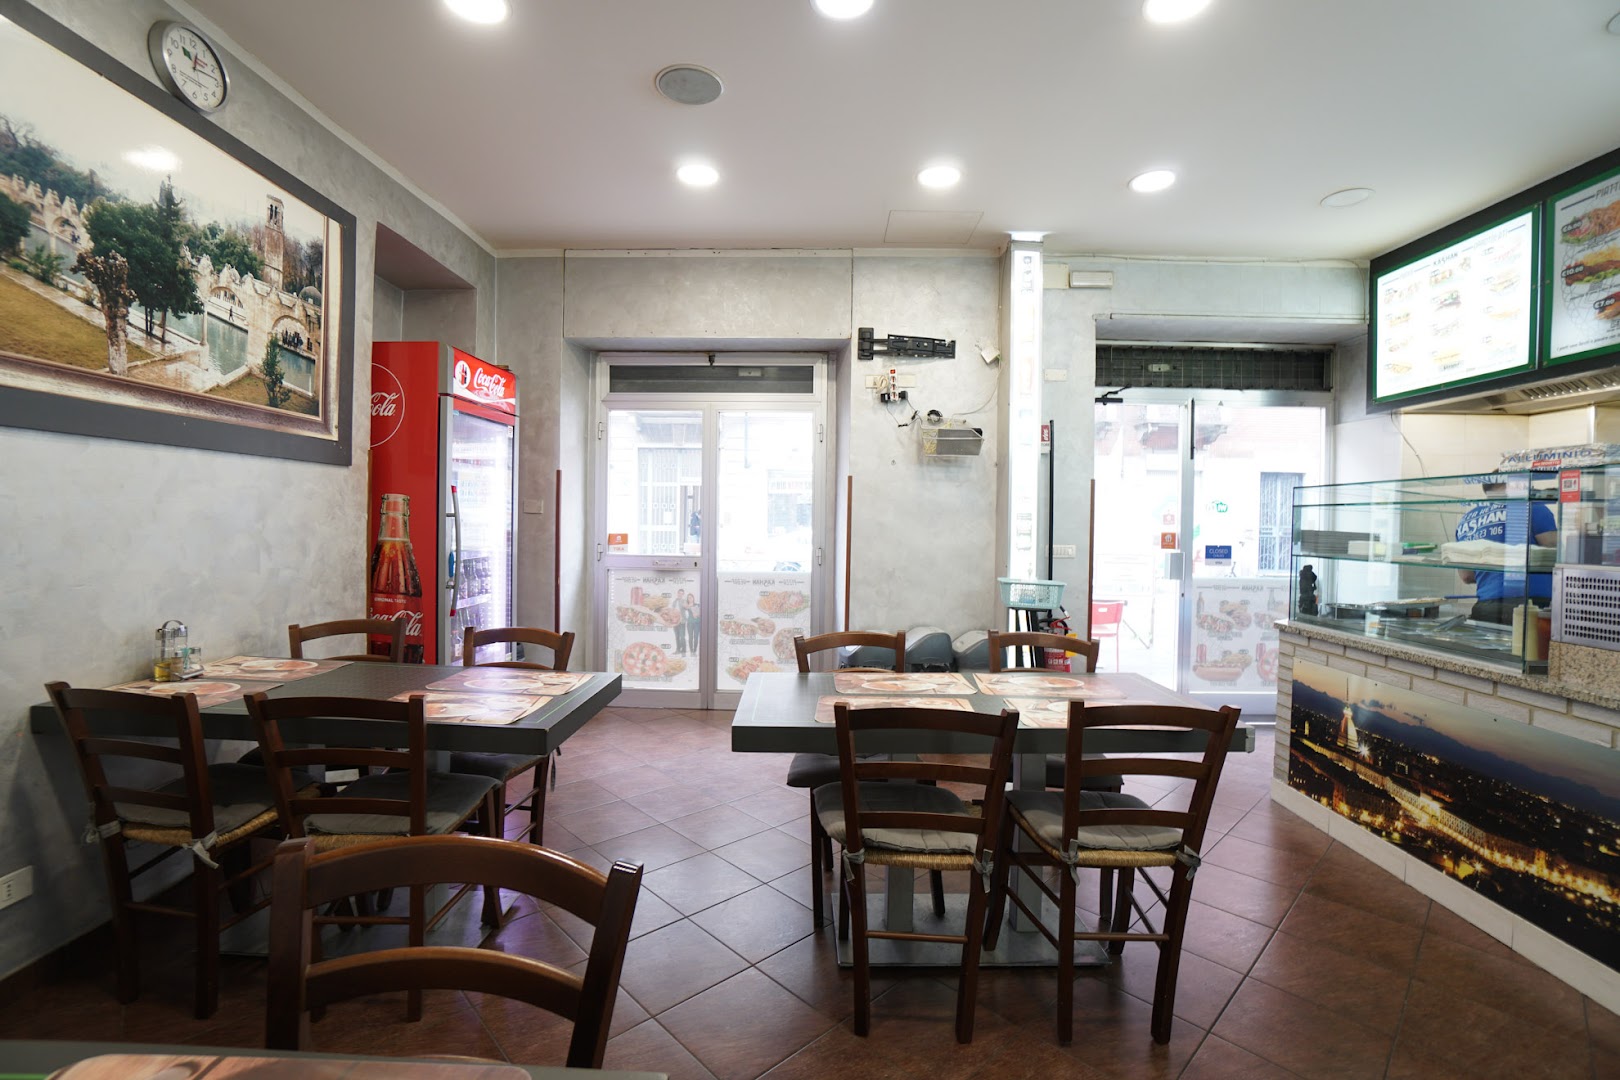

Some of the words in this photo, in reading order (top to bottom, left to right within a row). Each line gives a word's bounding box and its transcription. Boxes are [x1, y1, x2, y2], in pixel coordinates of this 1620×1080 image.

[170, 37, 179, 50] 10
[189, 37, 197, 50] 12
[171, 63, 177, 74] 8
[210, 64, 216, 74] 2
[181, 78, 187, 87] 7
[214, 79, 220, 88] 3
[192, 91, 198, 99] 6
[203, 93, 209, 101] 5
[211, 90, 216, 98] 4
[1507, 449, 1592, 463] ALLUMINIO
[1457, 511, 1506, 538] KASHAN
